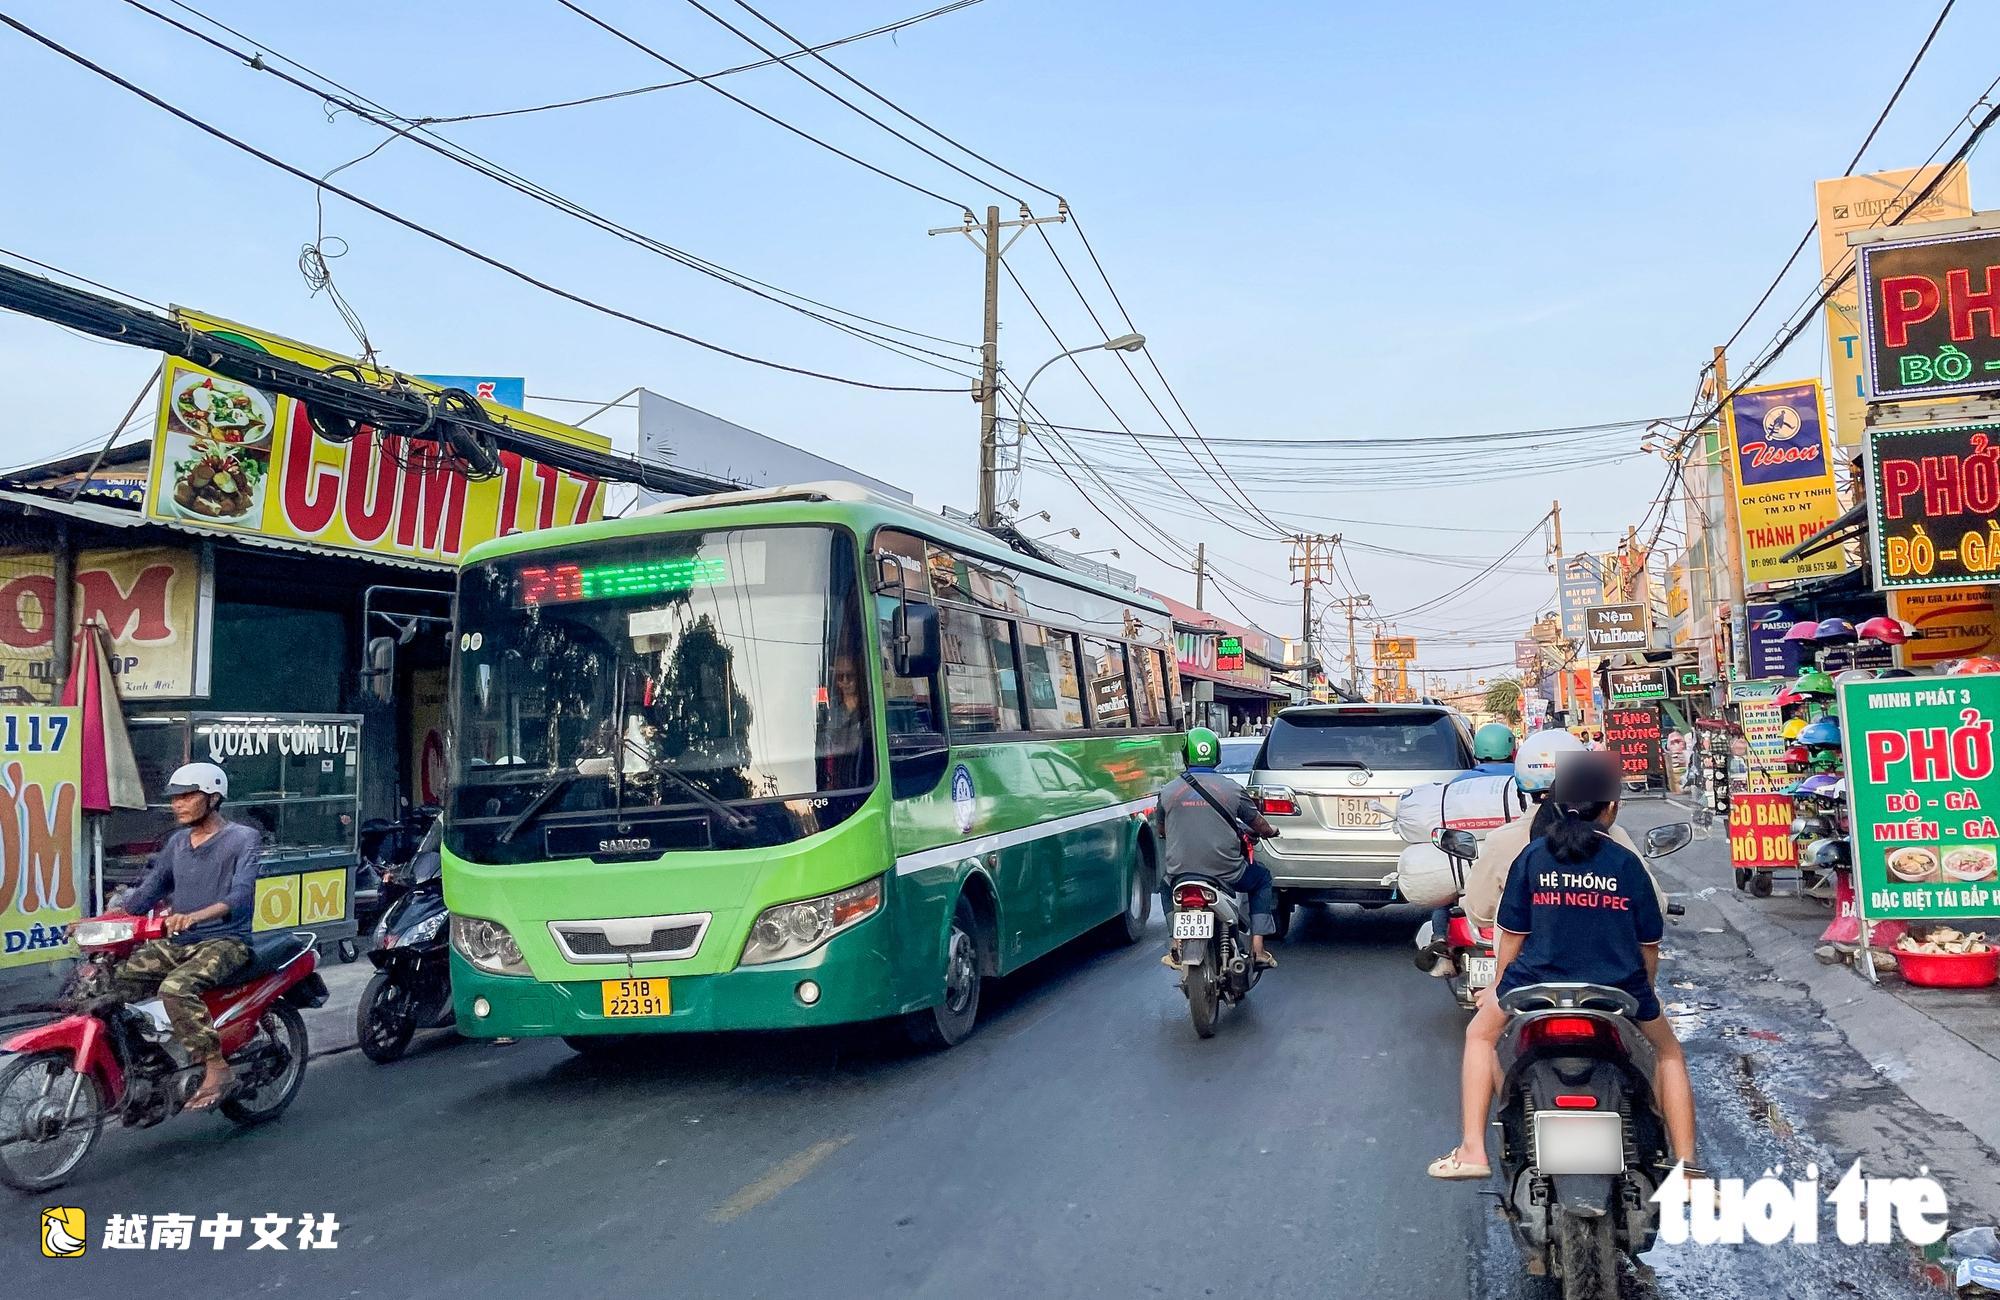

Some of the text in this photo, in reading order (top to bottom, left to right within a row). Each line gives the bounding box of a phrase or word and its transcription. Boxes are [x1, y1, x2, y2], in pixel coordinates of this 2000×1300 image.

[1900, 346, 1973, 386] BÒ
[1741, 442, 1819, 468] Tison
[1742, 487, 1832, 505] CN CÔNG TY TNHH
[1764, 502, 1812, 515] TM XD NT
[1746, 522, 1795, 549] THÀNH
[1762, 557, 1777, 567] 0903
[1598, 610, 1634, 624] Nệm
[1588, 627, 1645, 645] VinHome
[1613, 682, 1664, 693] VinHome
[1733, 686, 1764, 698] Rau
[1868, 687, 1971, 709] MINH PHÁT 3
[4, 716, 69, 753] 117
[208, 719, 350, 764] QUÁN CƠM 117
[1865, 707, 1995, 784] PHỞ
[1347, 799, 1370, 812] 51A
[1886, 788, 1921, 813] BÒ
[1944, 787, 1982, 810] GÀ
[1730, 801, 1791, 826] CÓ BÁN
[1873, 815, 1939, 842] MIẾN
[1963, 815, 2000, 839] GÀ
[599, 838, 651, 851] SAMCO
[1732, 831, 1758, 861] HỒ
[1762, 832, 1795, 861] BƠI
[1539, 871, 1617, 891] HỆ THỐNG
[1532, 891, 1631, 911] ANH NGỮ PEC
[1871, 888, 1899, 912] ĐẶC
[1902, 888, 1933, 911] BIỆT
[1935, 886, 1958, 907] TÁI
[1961, 884, 1989, 907] BẮP
[1180, 915, 1207, 925] 59-B1
[1176, 926, 1210, 937] 658.31
[620, 982, 651, 997] 51B
[610, 998, 662, 1016] 223.91
